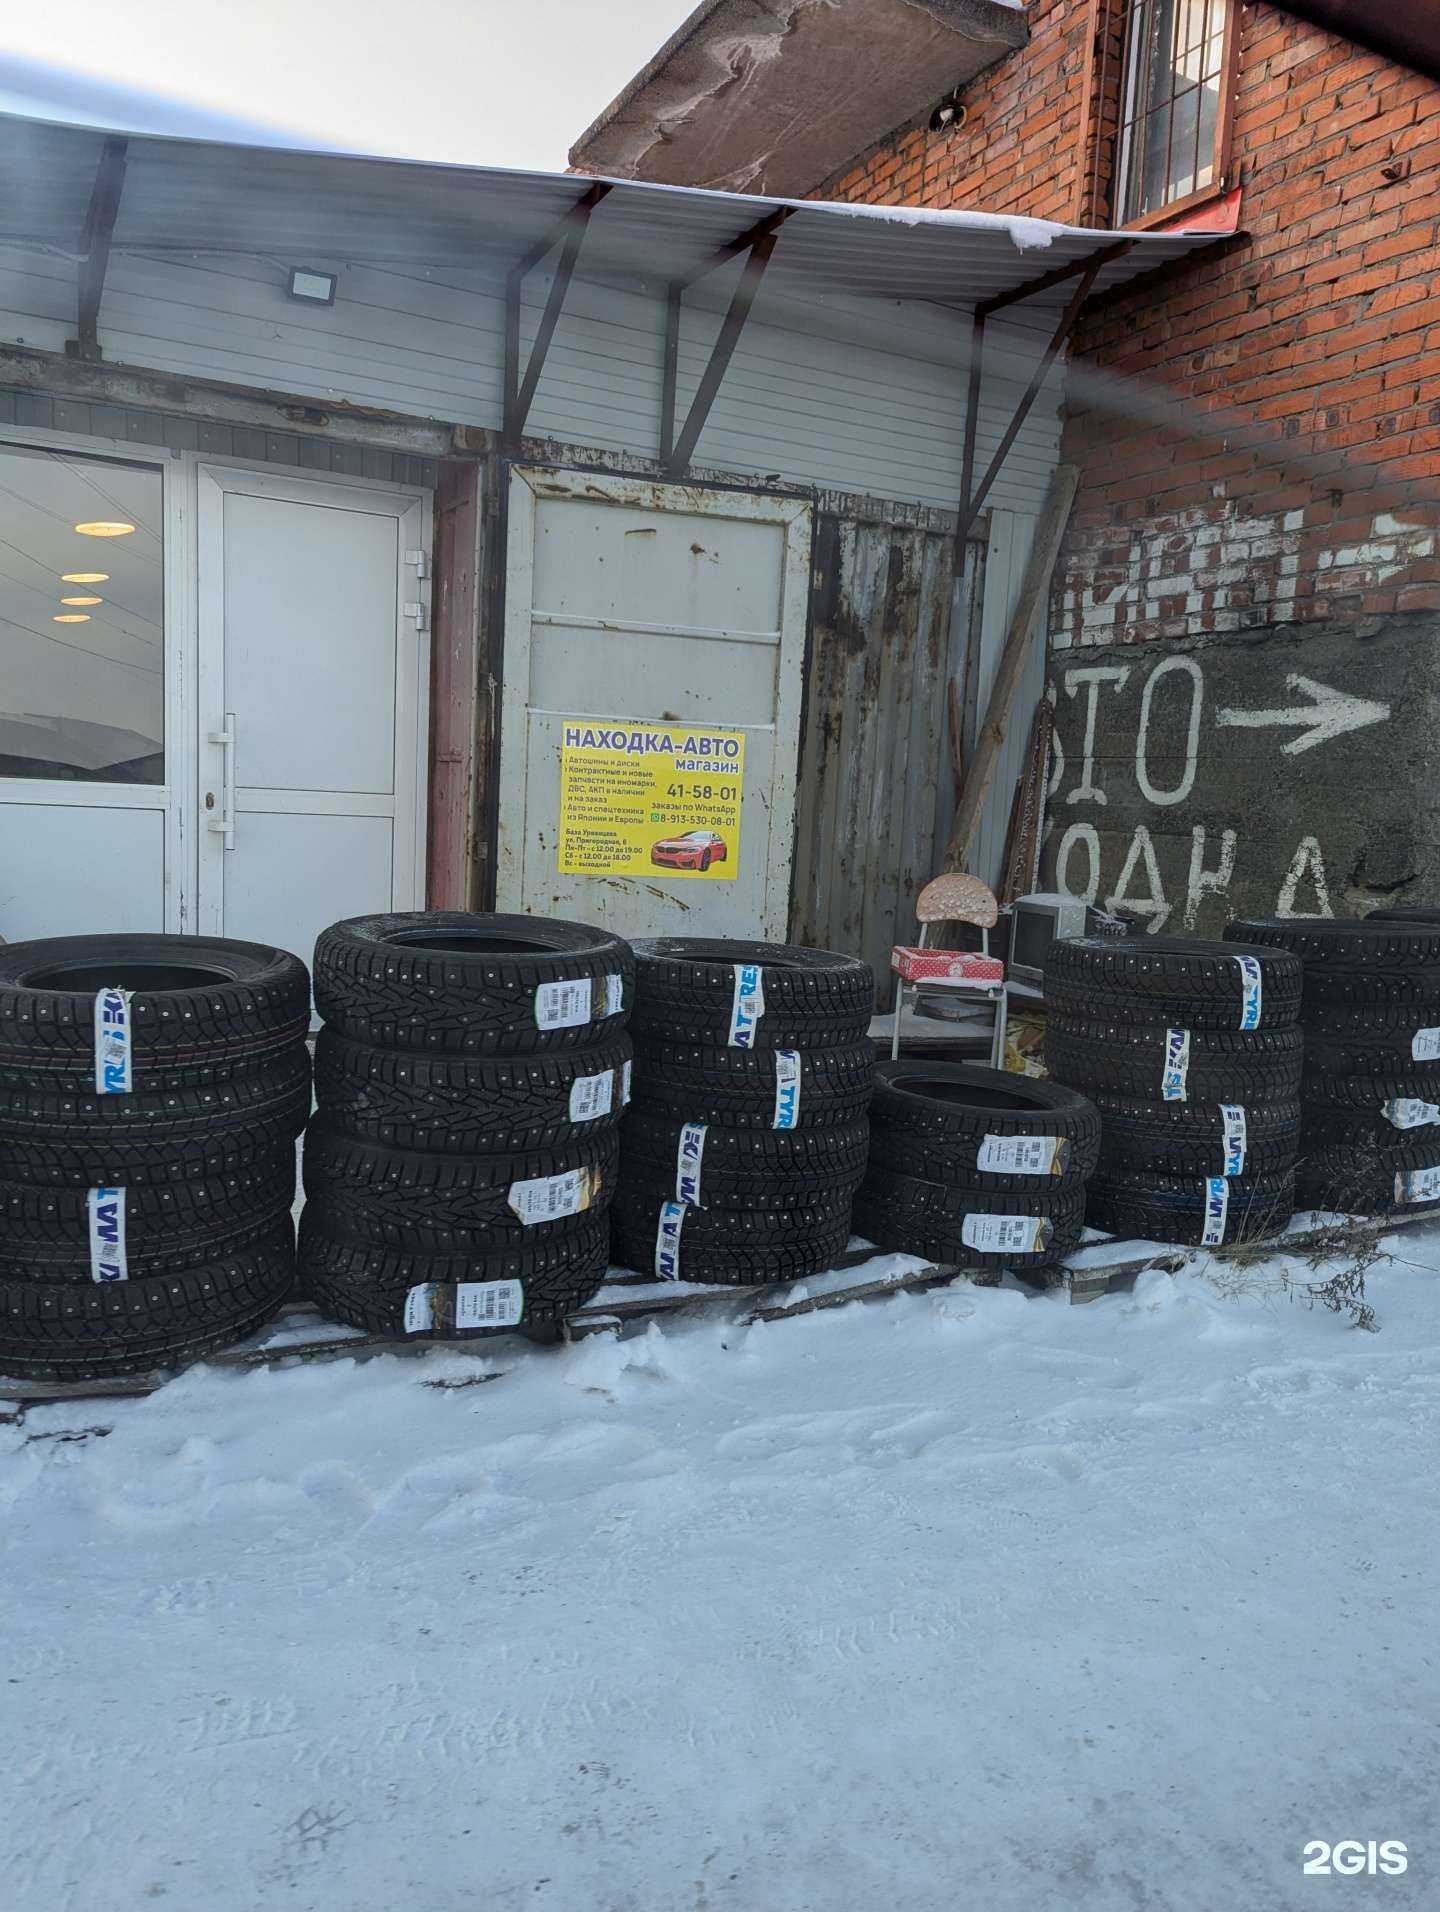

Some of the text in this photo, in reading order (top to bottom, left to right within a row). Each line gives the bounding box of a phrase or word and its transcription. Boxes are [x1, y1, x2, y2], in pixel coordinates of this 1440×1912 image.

[565, 727, 740, 758] НАХОДКА-АВТО
[569, 757, 609, 765] Автошины
[616, 760, 640, 768] диски
[675, 759, 740, 774] магазин
[568, 766, 621, 776] Контрактные
[568, 776, 605, 785] запчасти
[567, 785, 587, 795] ДВС,
[588, 785, 605, 794] АКП
[611, 788, 645, 797] наличии
[666, 783, 737, 801] 41-58-01
[586, 796, 608, 804] заказ
[567, 804, 587, 812] Авто
[593, 806, 645, 815] спецтехника
[650, 802, 736, 815] заказы по WhatsApp
[577, 814, 608, 823] Японии
[614, 816, 644, 825] Европы
[660, 814, 736, 826] 8-913-530-08-01
[624, 847, 643, 855] 19.00
[578, 861, 611, 869] выходной
